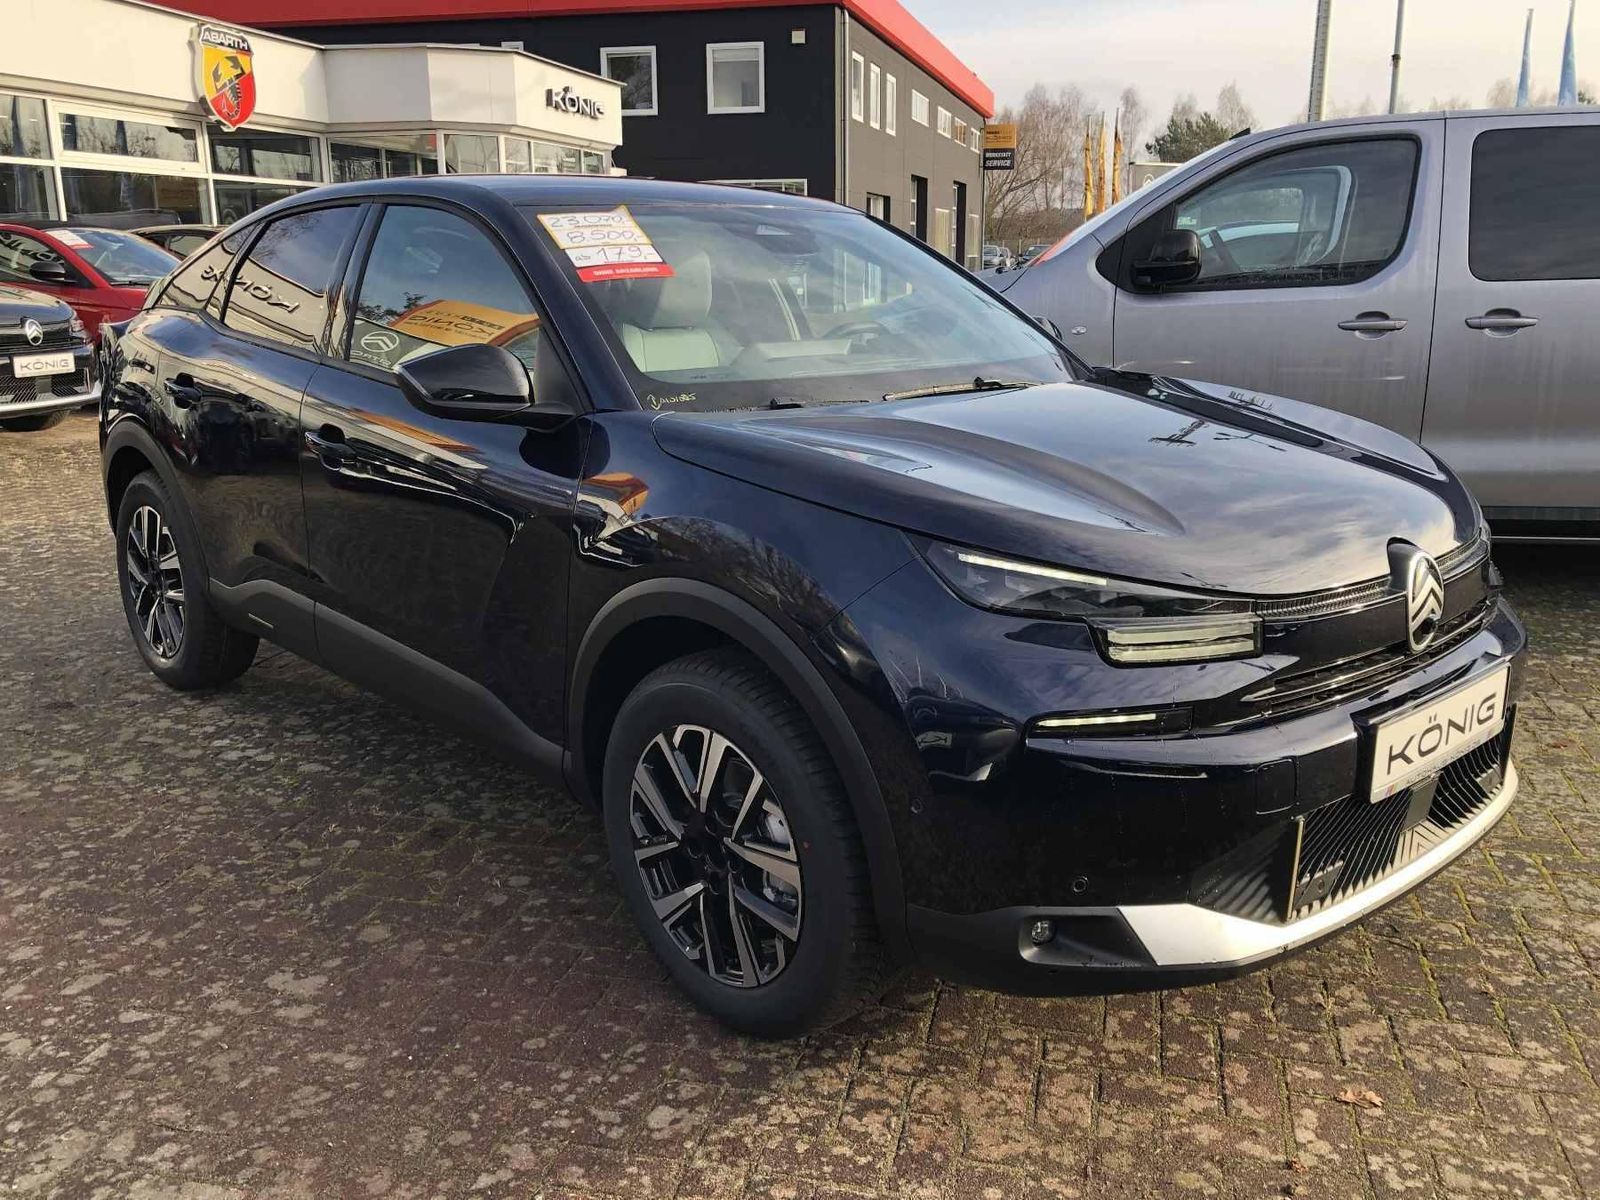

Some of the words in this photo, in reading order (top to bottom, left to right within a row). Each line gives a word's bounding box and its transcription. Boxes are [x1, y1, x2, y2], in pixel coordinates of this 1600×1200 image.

[203, 31, 248, 50] ABARTH
[19, 358, 70, 372] KÖNIG
[1386, 692, 1497, 775] KÖNIG
